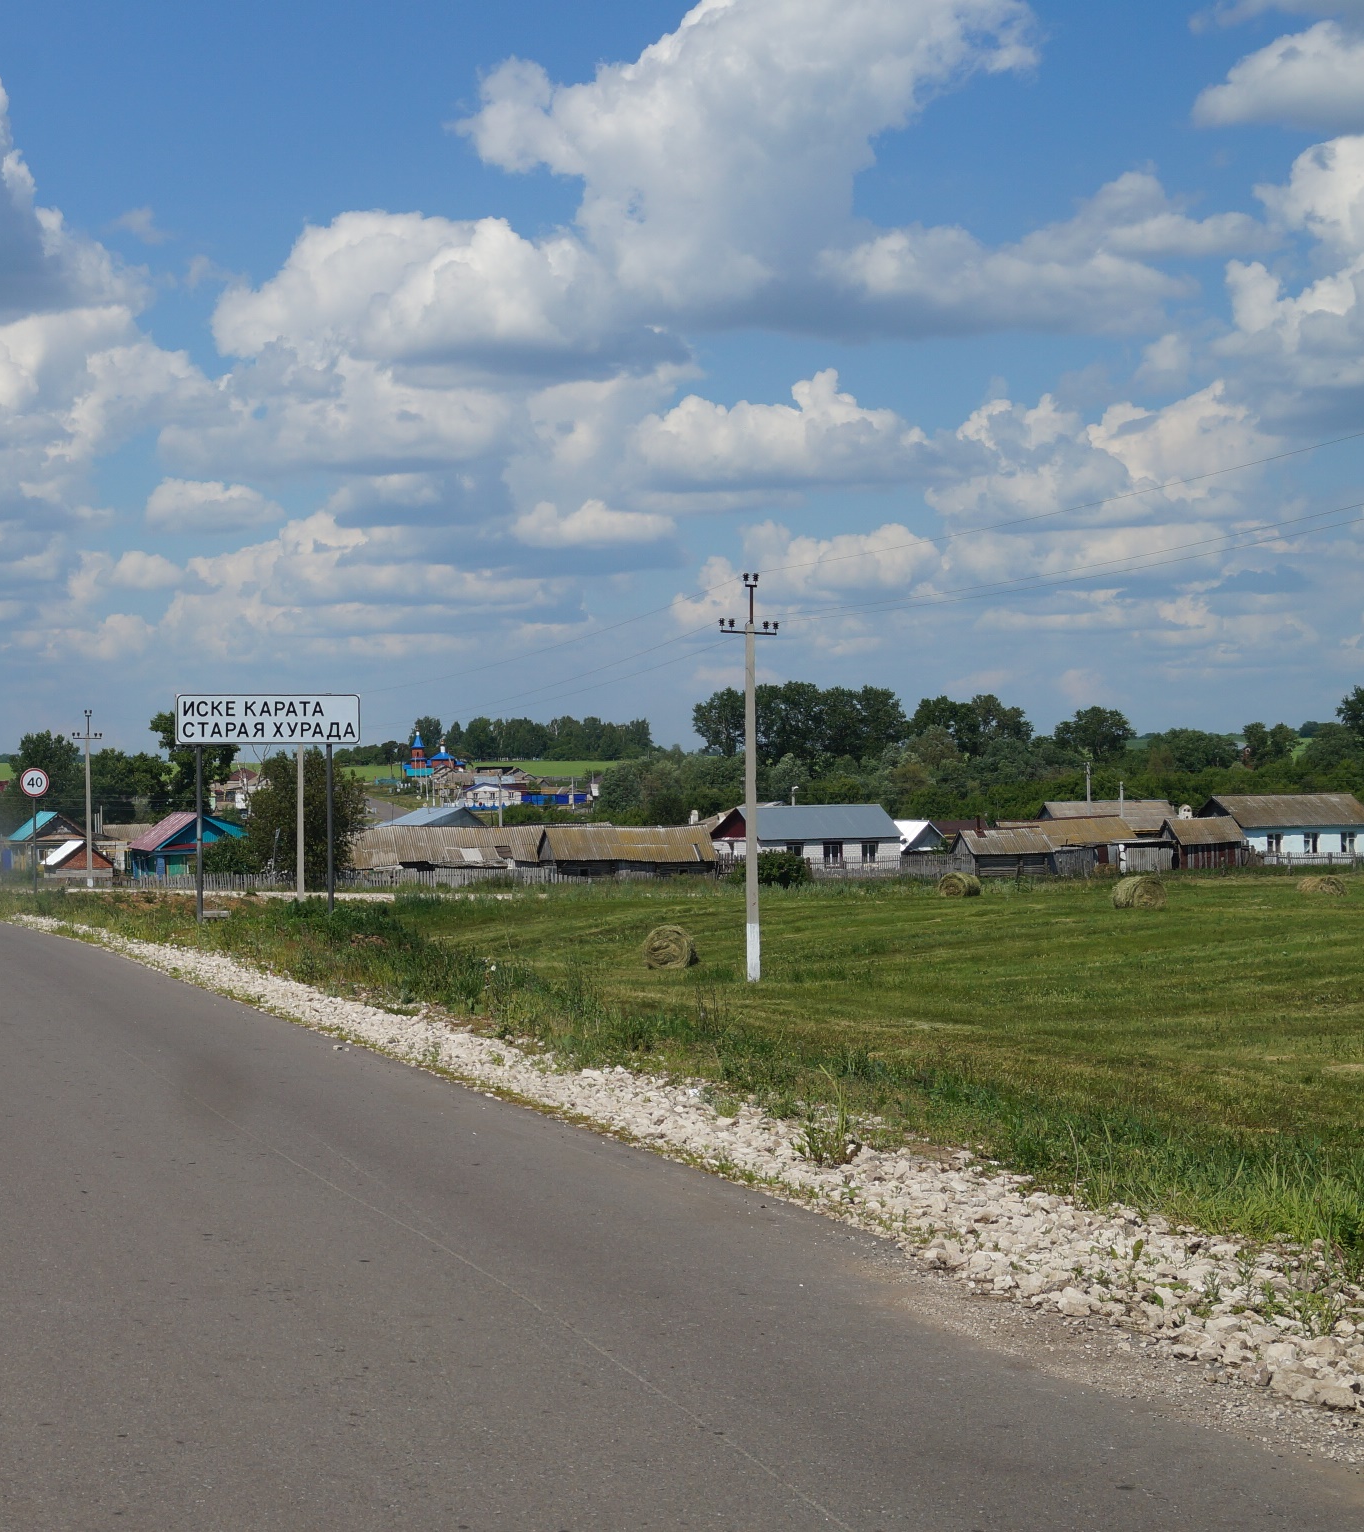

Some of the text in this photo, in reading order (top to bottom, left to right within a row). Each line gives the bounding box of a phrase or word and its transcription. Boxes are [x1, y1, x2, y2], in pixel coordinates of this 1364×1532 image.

[183, 701, 325, 717] ИСКЕ КАРАТА
[183, 722, 356, 740] СТАРАЯ ХУРАДА
[27, 777, 43, 788] 40
